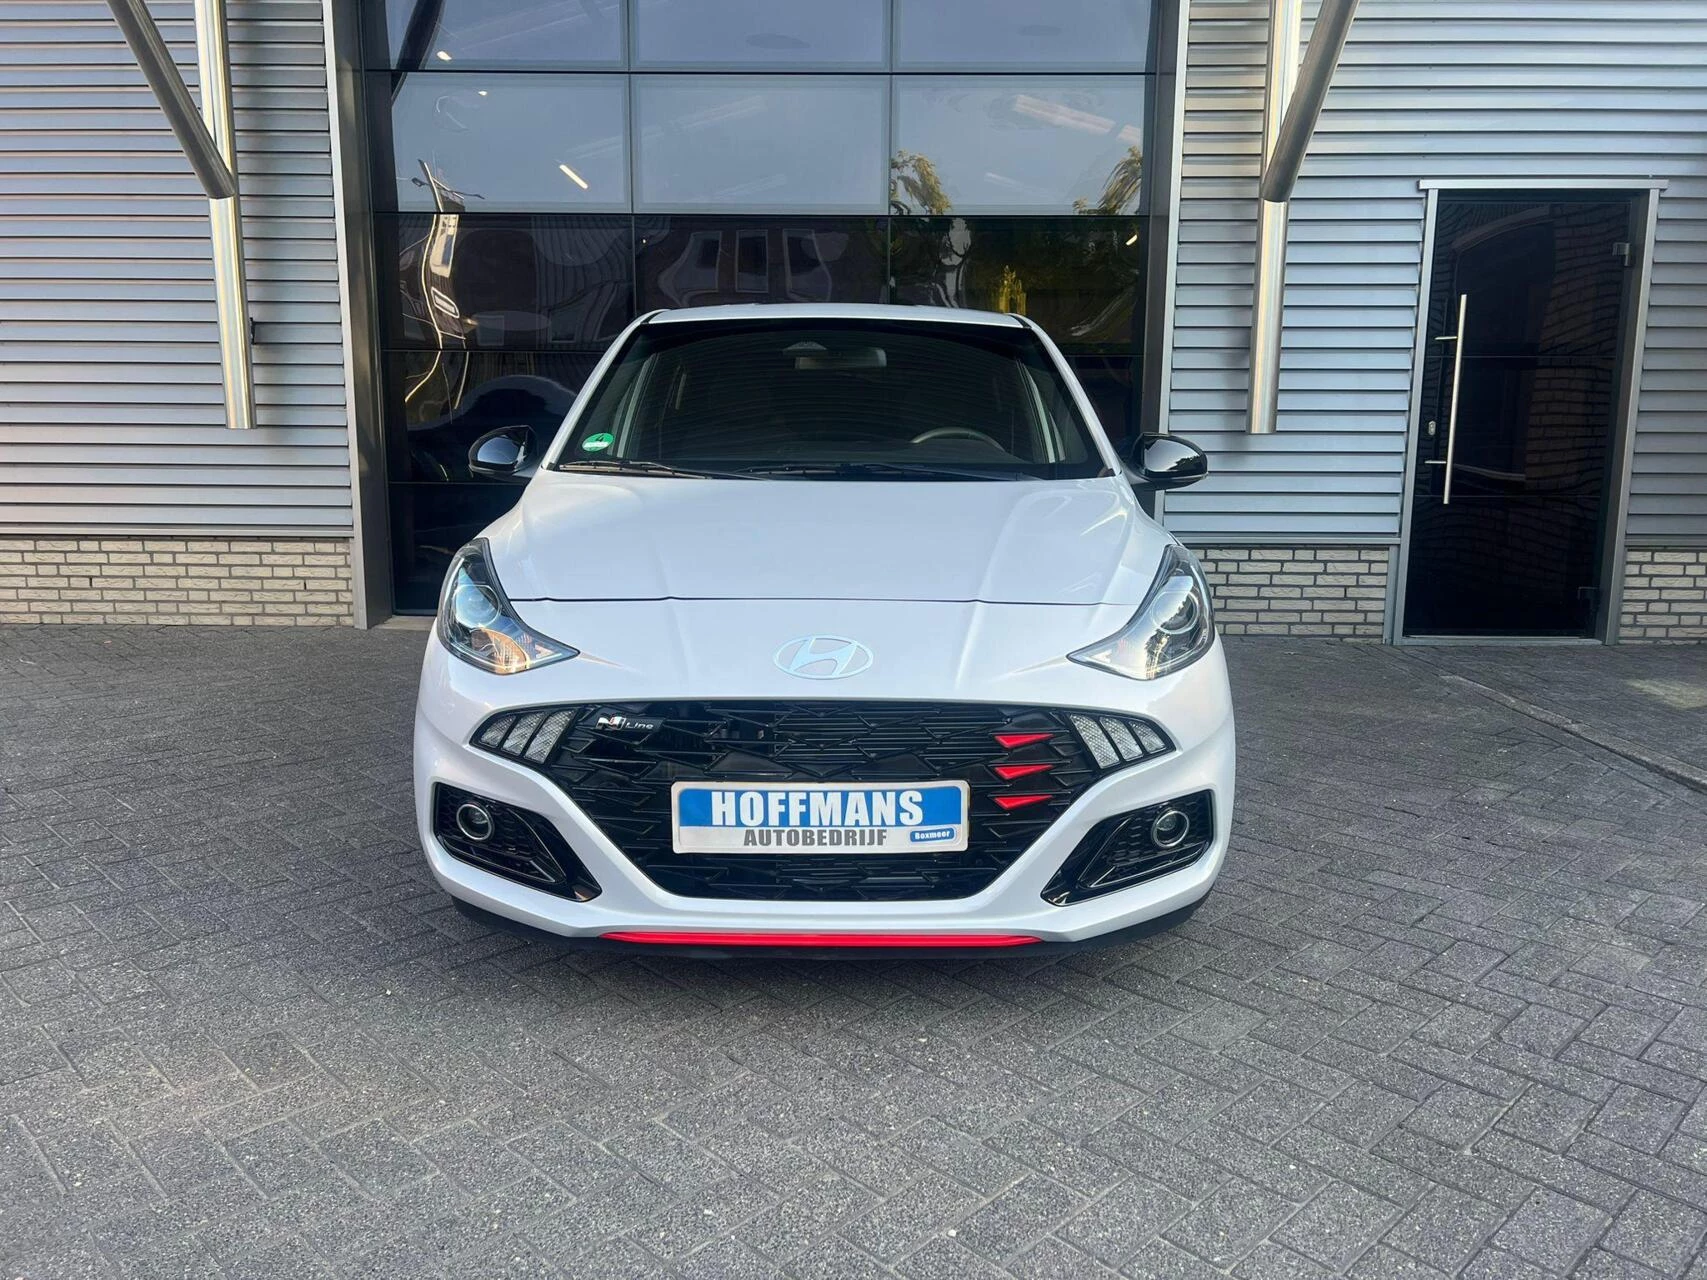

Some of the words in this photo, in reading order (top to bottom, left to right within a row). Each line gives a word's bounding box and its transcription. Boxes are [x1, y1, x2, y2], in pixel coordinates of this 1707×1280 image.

[711, 790, 923, 827] HOFFMANS
[743, 828, 888, 847] AUTOBEDRIJF
[914, 830, 951, 840] Boxmeer
